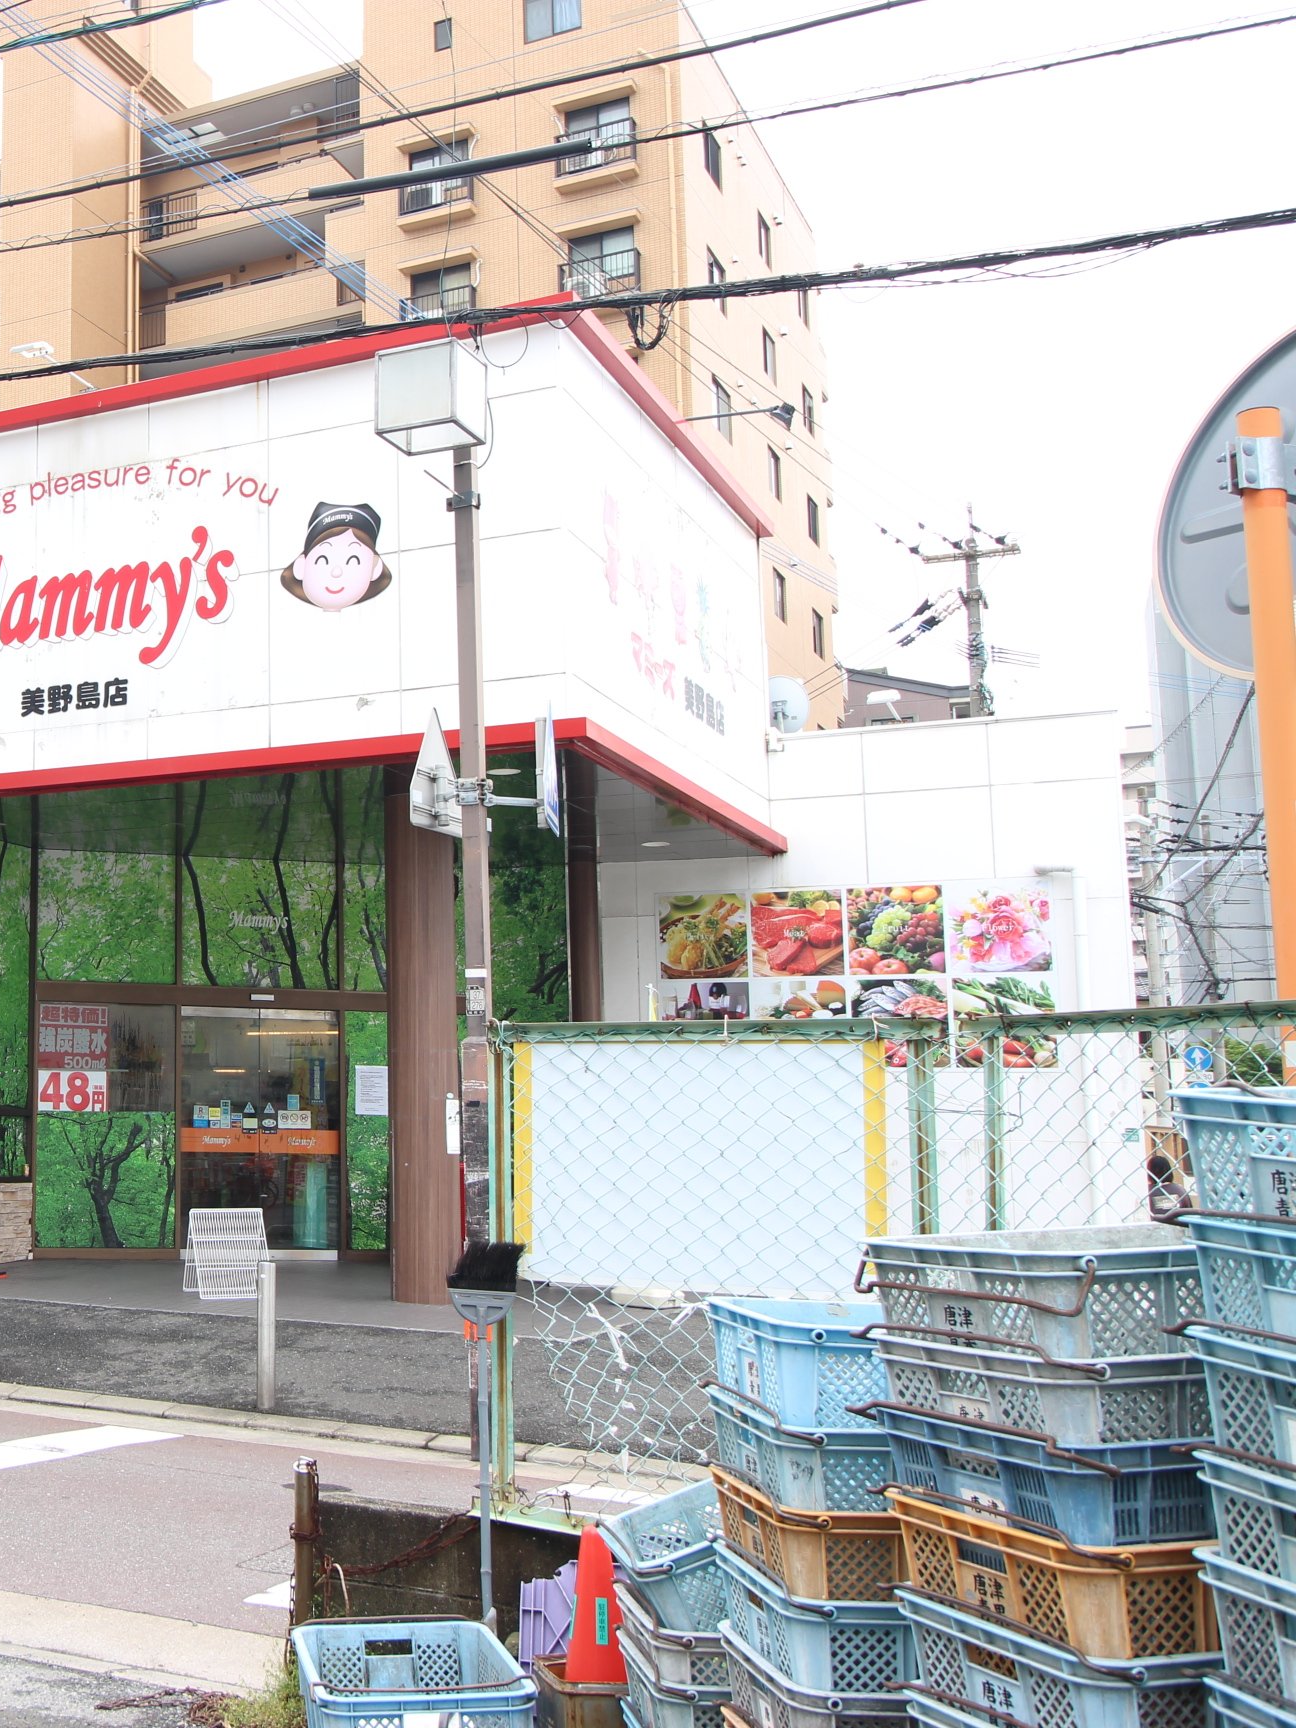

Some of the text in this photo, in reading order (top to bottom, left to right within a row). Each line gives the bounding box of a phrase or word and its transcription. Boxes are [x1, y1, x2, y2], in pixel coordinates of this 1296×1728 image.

[30, 465, 150, 505] pleasure
[167, 458, 211, 488] for
[223, 472, 279, 506] you
[20, 677, 129, 717] 美野島店
[684, 676, 725, 736] 美野島店
[228, 910, 288, 934] Mammy's
[39, 1027, 107, 1054] 強炭酸水
[39, 1071, 105, 1112] 48円
[944, 1304, 973, 1329] 唐津
[973, 1572, 1004, 1601] 唐津
[982, 1680, 1014, 1709] 唐津
